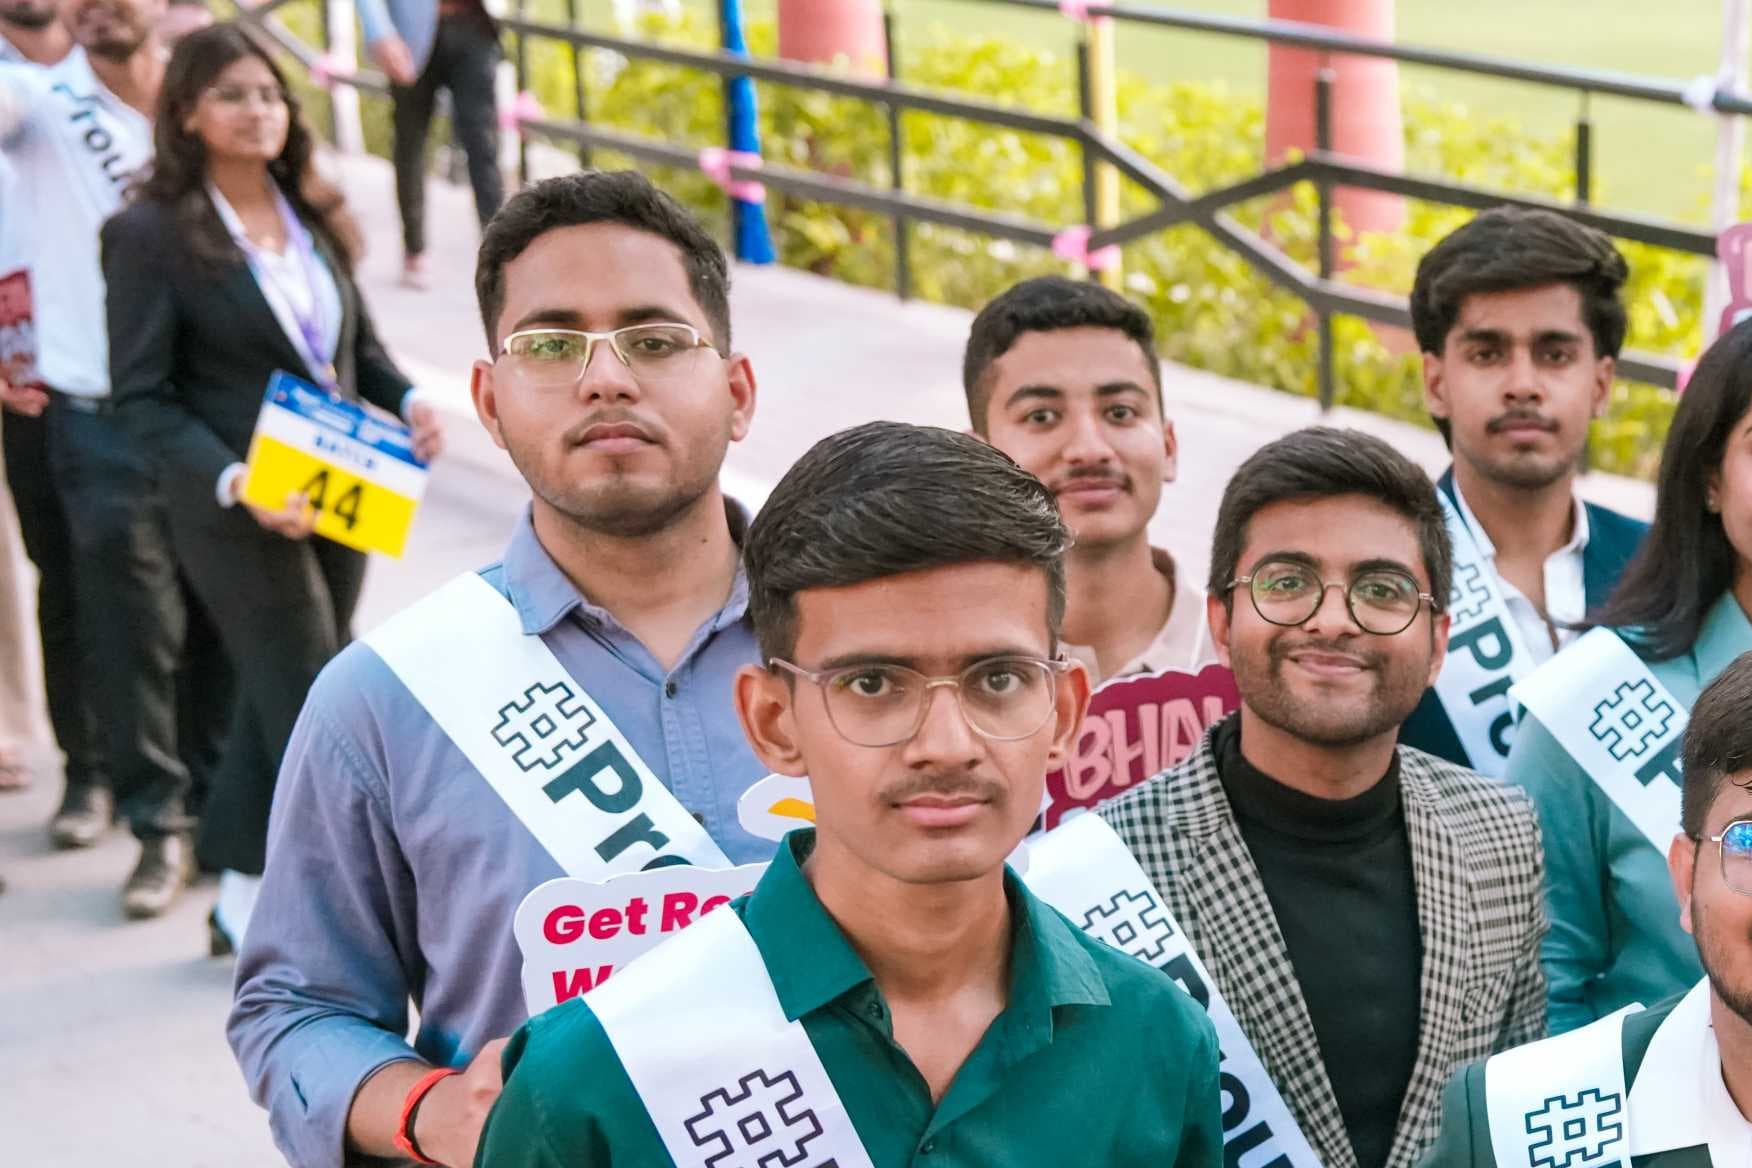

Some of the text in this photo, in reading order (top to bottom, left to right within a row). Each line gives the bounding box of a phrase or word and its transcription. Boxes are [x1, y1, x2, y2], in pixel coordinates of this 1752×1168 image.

[303, 470, 362, 530] 44
[490, 681, 693, 871] #Pr
[543, 903, 648, 945] Get
